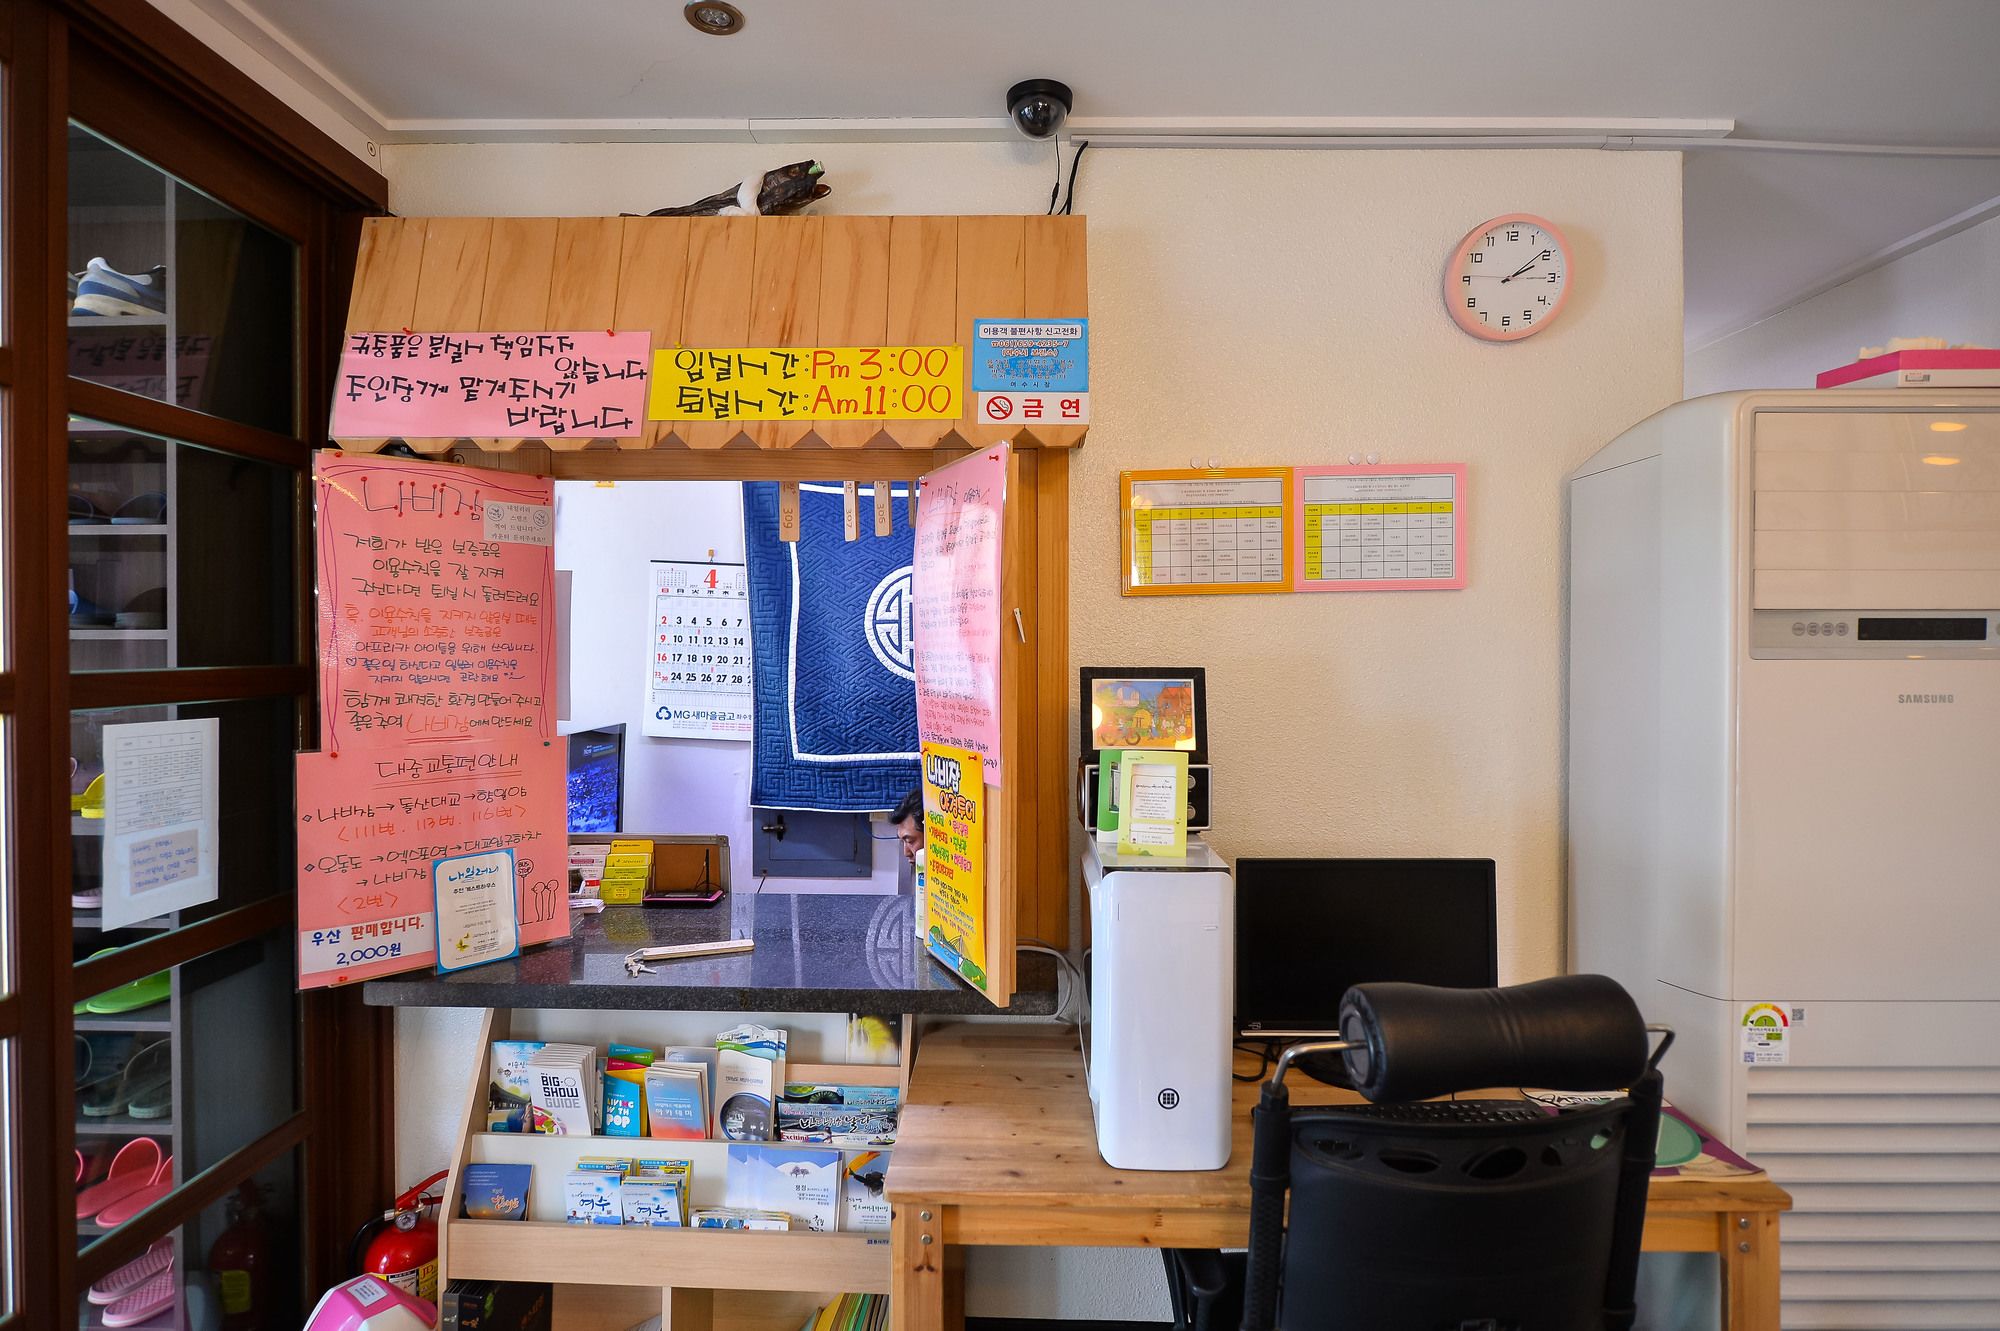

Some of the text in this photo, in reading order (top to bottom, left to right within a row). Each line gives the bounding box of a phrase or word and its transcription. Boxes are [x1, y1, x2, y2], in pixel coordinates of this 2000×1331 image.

[1486, 236, 1495, 247] 11
[1505, 230, 1519, 242] 12
[1530, 234, 1536, 246] 1
[1470, 252, 1483, 263] 10
[1541, 249, 1551, 261] 2
[1462, 275, 1471, 286] 9
[1547, 272, 1556, 283] 3
[1467, 297, 1476, 308] 8
[1537, 295, 1546, 306] 4
[1479, 311, 1488, 322] 7
[1501, 316, 1511, 327] 6
[1523, 309, 1532, 321] 5
[983, 327, 1079, 336] 이용객 불편사항 신고전화
[428, 334, 485, 364] 분실시
[554, 355, 648, 385] 않습니다
[858, 348, 950, 381] 3:00
[458, 375, 577, 403] 맡겨주시기
[861, 384, 953, 416] 11:00
[506, 403, 634, 436] 바랍니다
[782, 507, 794, 529] 309
[845, 508, 853, 529] 307
[343, 533, 407, 550] 저희가
[415, 538, 443, 554] 받은
[452, 538, 501, 558] 보증금은
[372, 557, 504, 581] 이용수칙을 잘 지켜
[702, 568, 720, 589] 4
[351, 577, 421, 597] 주신다면
[481, 584, 540, 607] 돌려드려요
[368, 605, 432, 624] 이용수칙을
[439, 608, 477, 622] 지키지
[514, 612, 537, 625] 때는
[661, 616, 742, 629] 2 3 4 5 6 7
[370, 625, 502, 639] 고객님의 소중한 보증금은
[355, 641, 410, 653] 아프리카
[413, 641, 457, 655] 아이들을
[462, 642, 486, 654] 위해
[660, 634, 744, 648] 9 10 11 12 13 14
[399, 659, 441, 671] 하신다고
[445, 659, 474, 671] 일부러
[657, 652, 743, 667] 16 17 18 19 20 21
[368, 675, 403, 684] 지키지
[670, 671, 743, 686] 24 25 26 27 28
[342, 689, 391, 709] 함께
[394, 692, 443, 709] 쾌적한
[1898, 694, 1954, 704] SAMSUNG
[344, 710, 373, 732] 좋은
[373, 711, 403, 730] 추억
[926, 752, 962, 794] 나비잠
[399, 792, 462, 815] 돌산대교
[476, 785, 528, 804] 향일암
[938, 789, 977, 823] 야경투어
[317, 853, 362, 875] 오동도
[386, 844, 449, 865] 엑스포역
[373, 867, 428, 886] 나비잠
[311, 915, 426, 946] 우산 판매합니다.
[336, 941, 402, 967] 2,000원
[543, 1086, 579, 1098] SHOW
[545, 1097, 581, 1109] GUIDE
[607, 1097, 635, 1108] LIVING
[606, 1113, 631, 1128] POP
[579, 1196, 611, 1211] 여수
[637, 1204, 668, 1218] 여수
